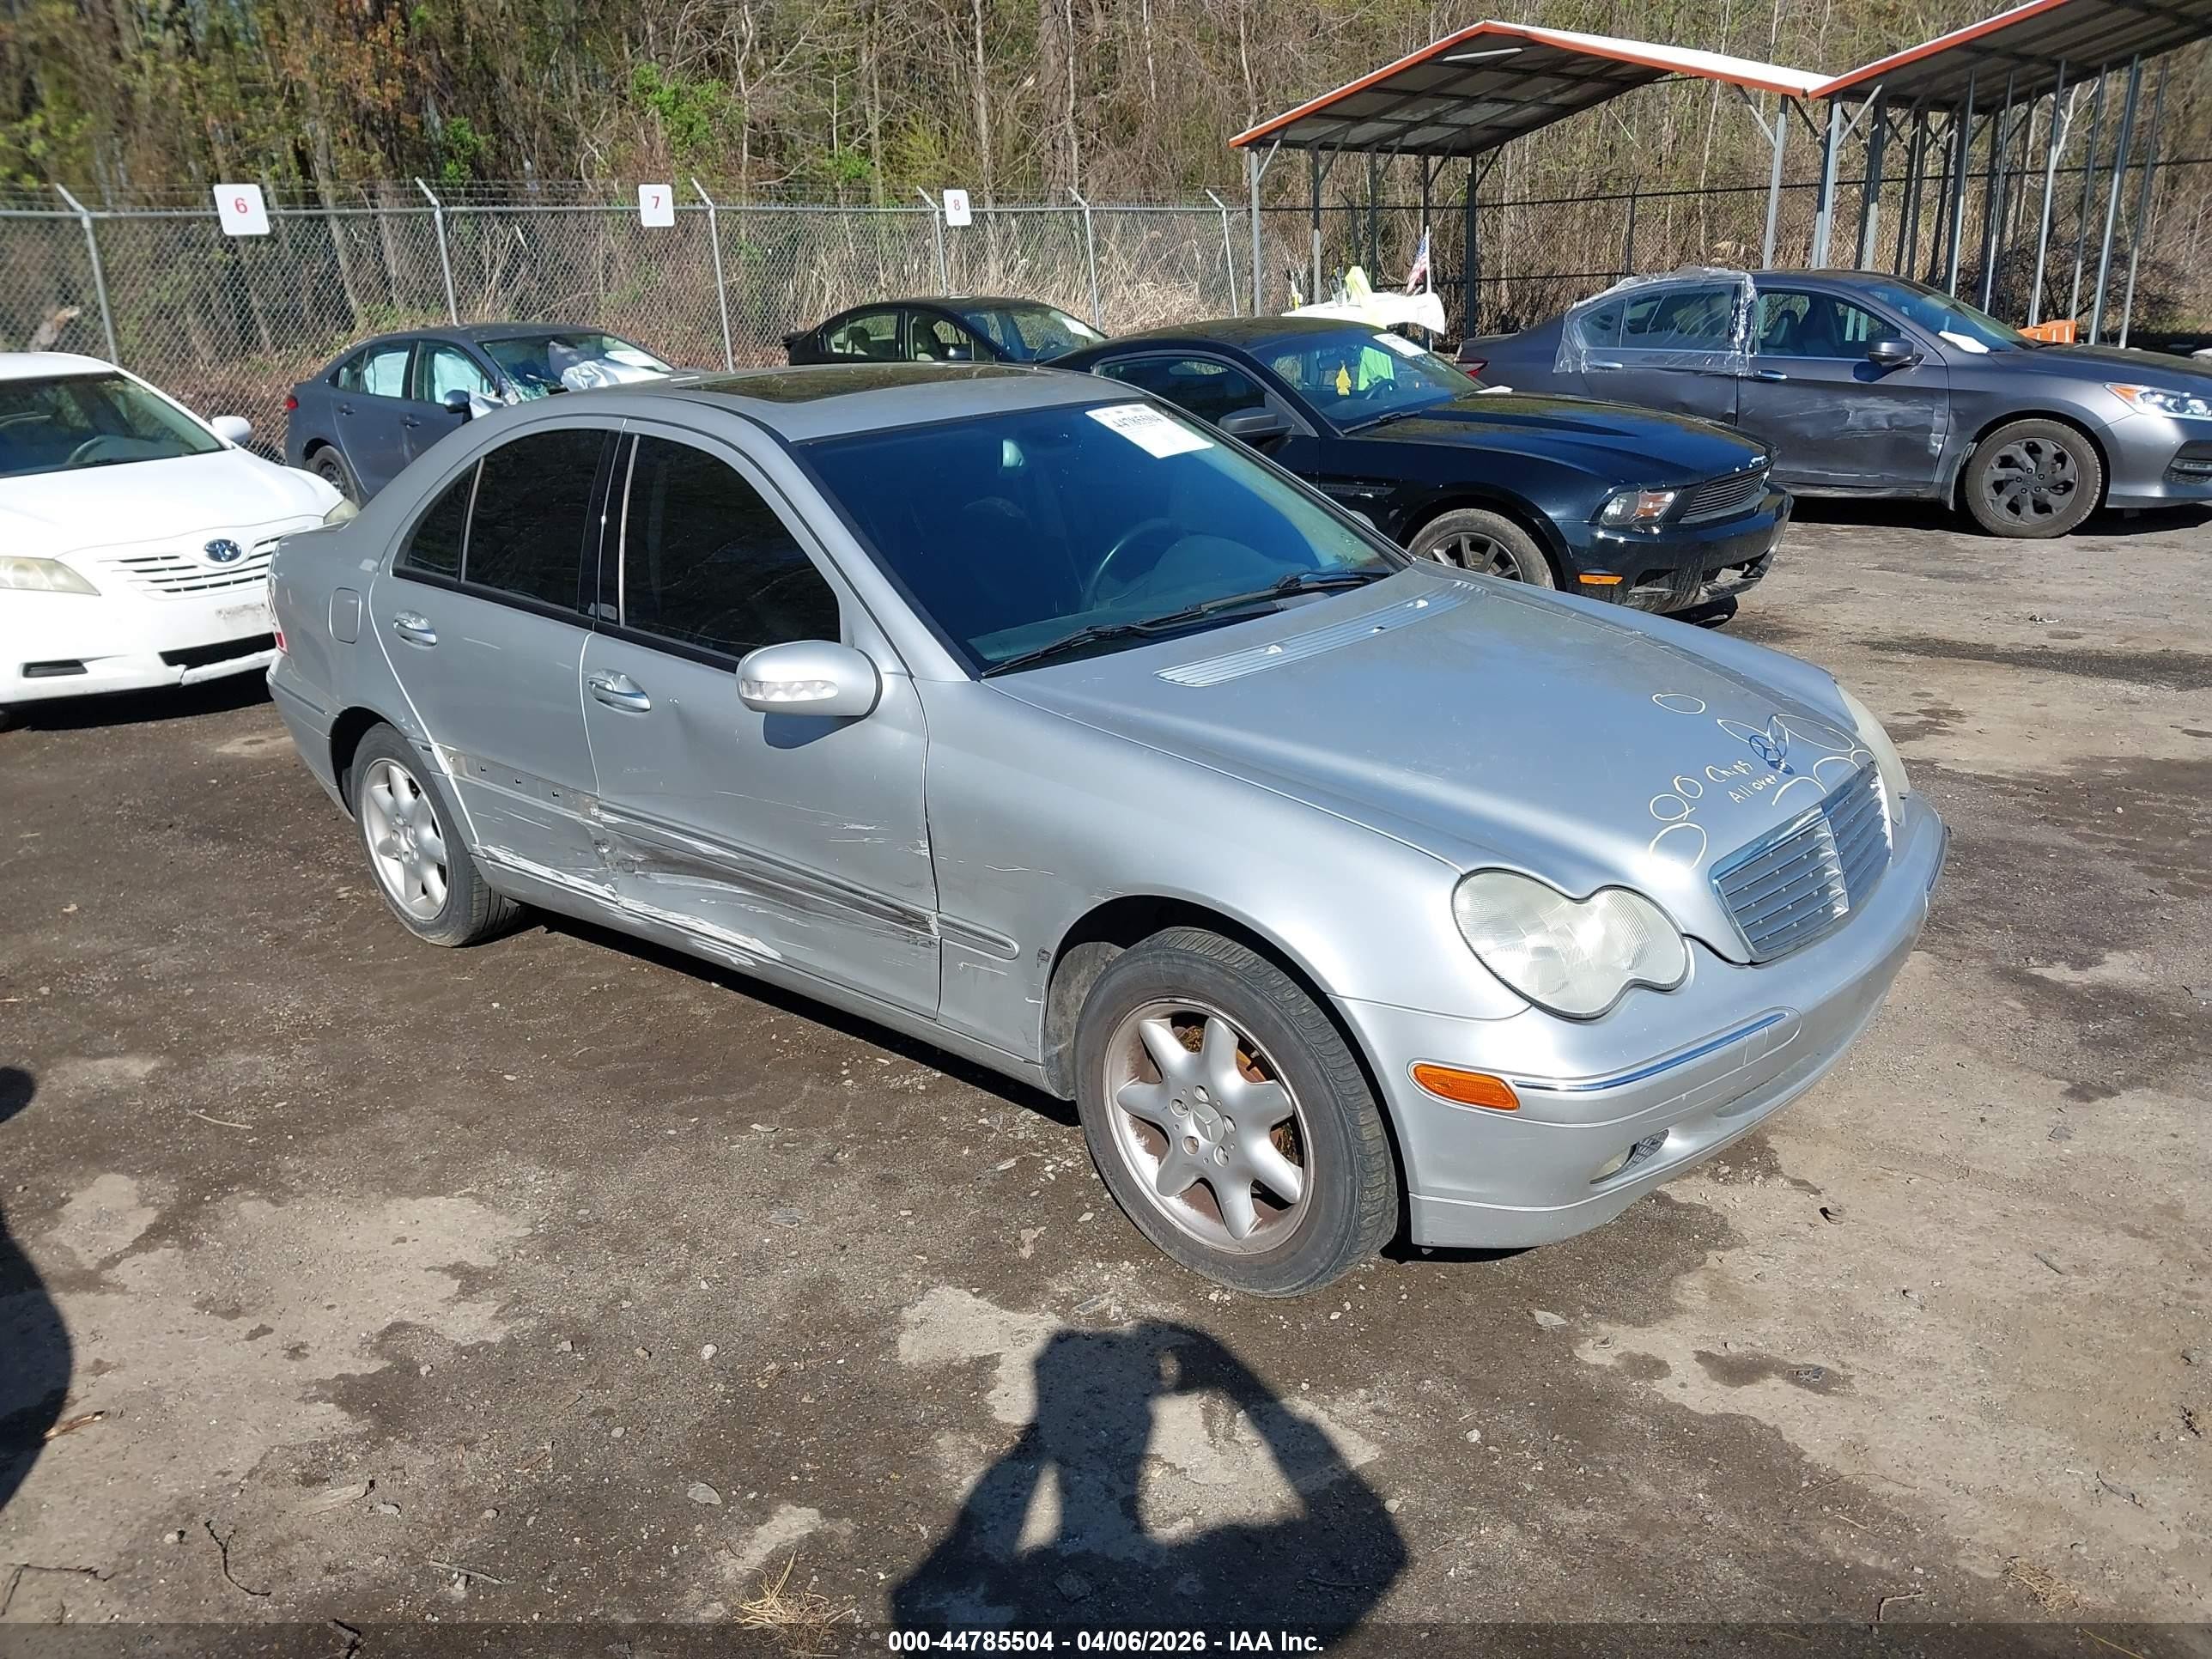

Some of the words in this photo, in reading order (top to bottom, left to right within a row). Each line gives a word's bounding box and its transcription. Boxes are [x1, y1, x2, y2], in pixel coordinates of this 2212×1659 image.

[234, 198, 248, 214] 6
[652, 196, 659, 209] 7
[953, 198, 961, 211] 8
[1705, 760, 1753, 783] Chips
